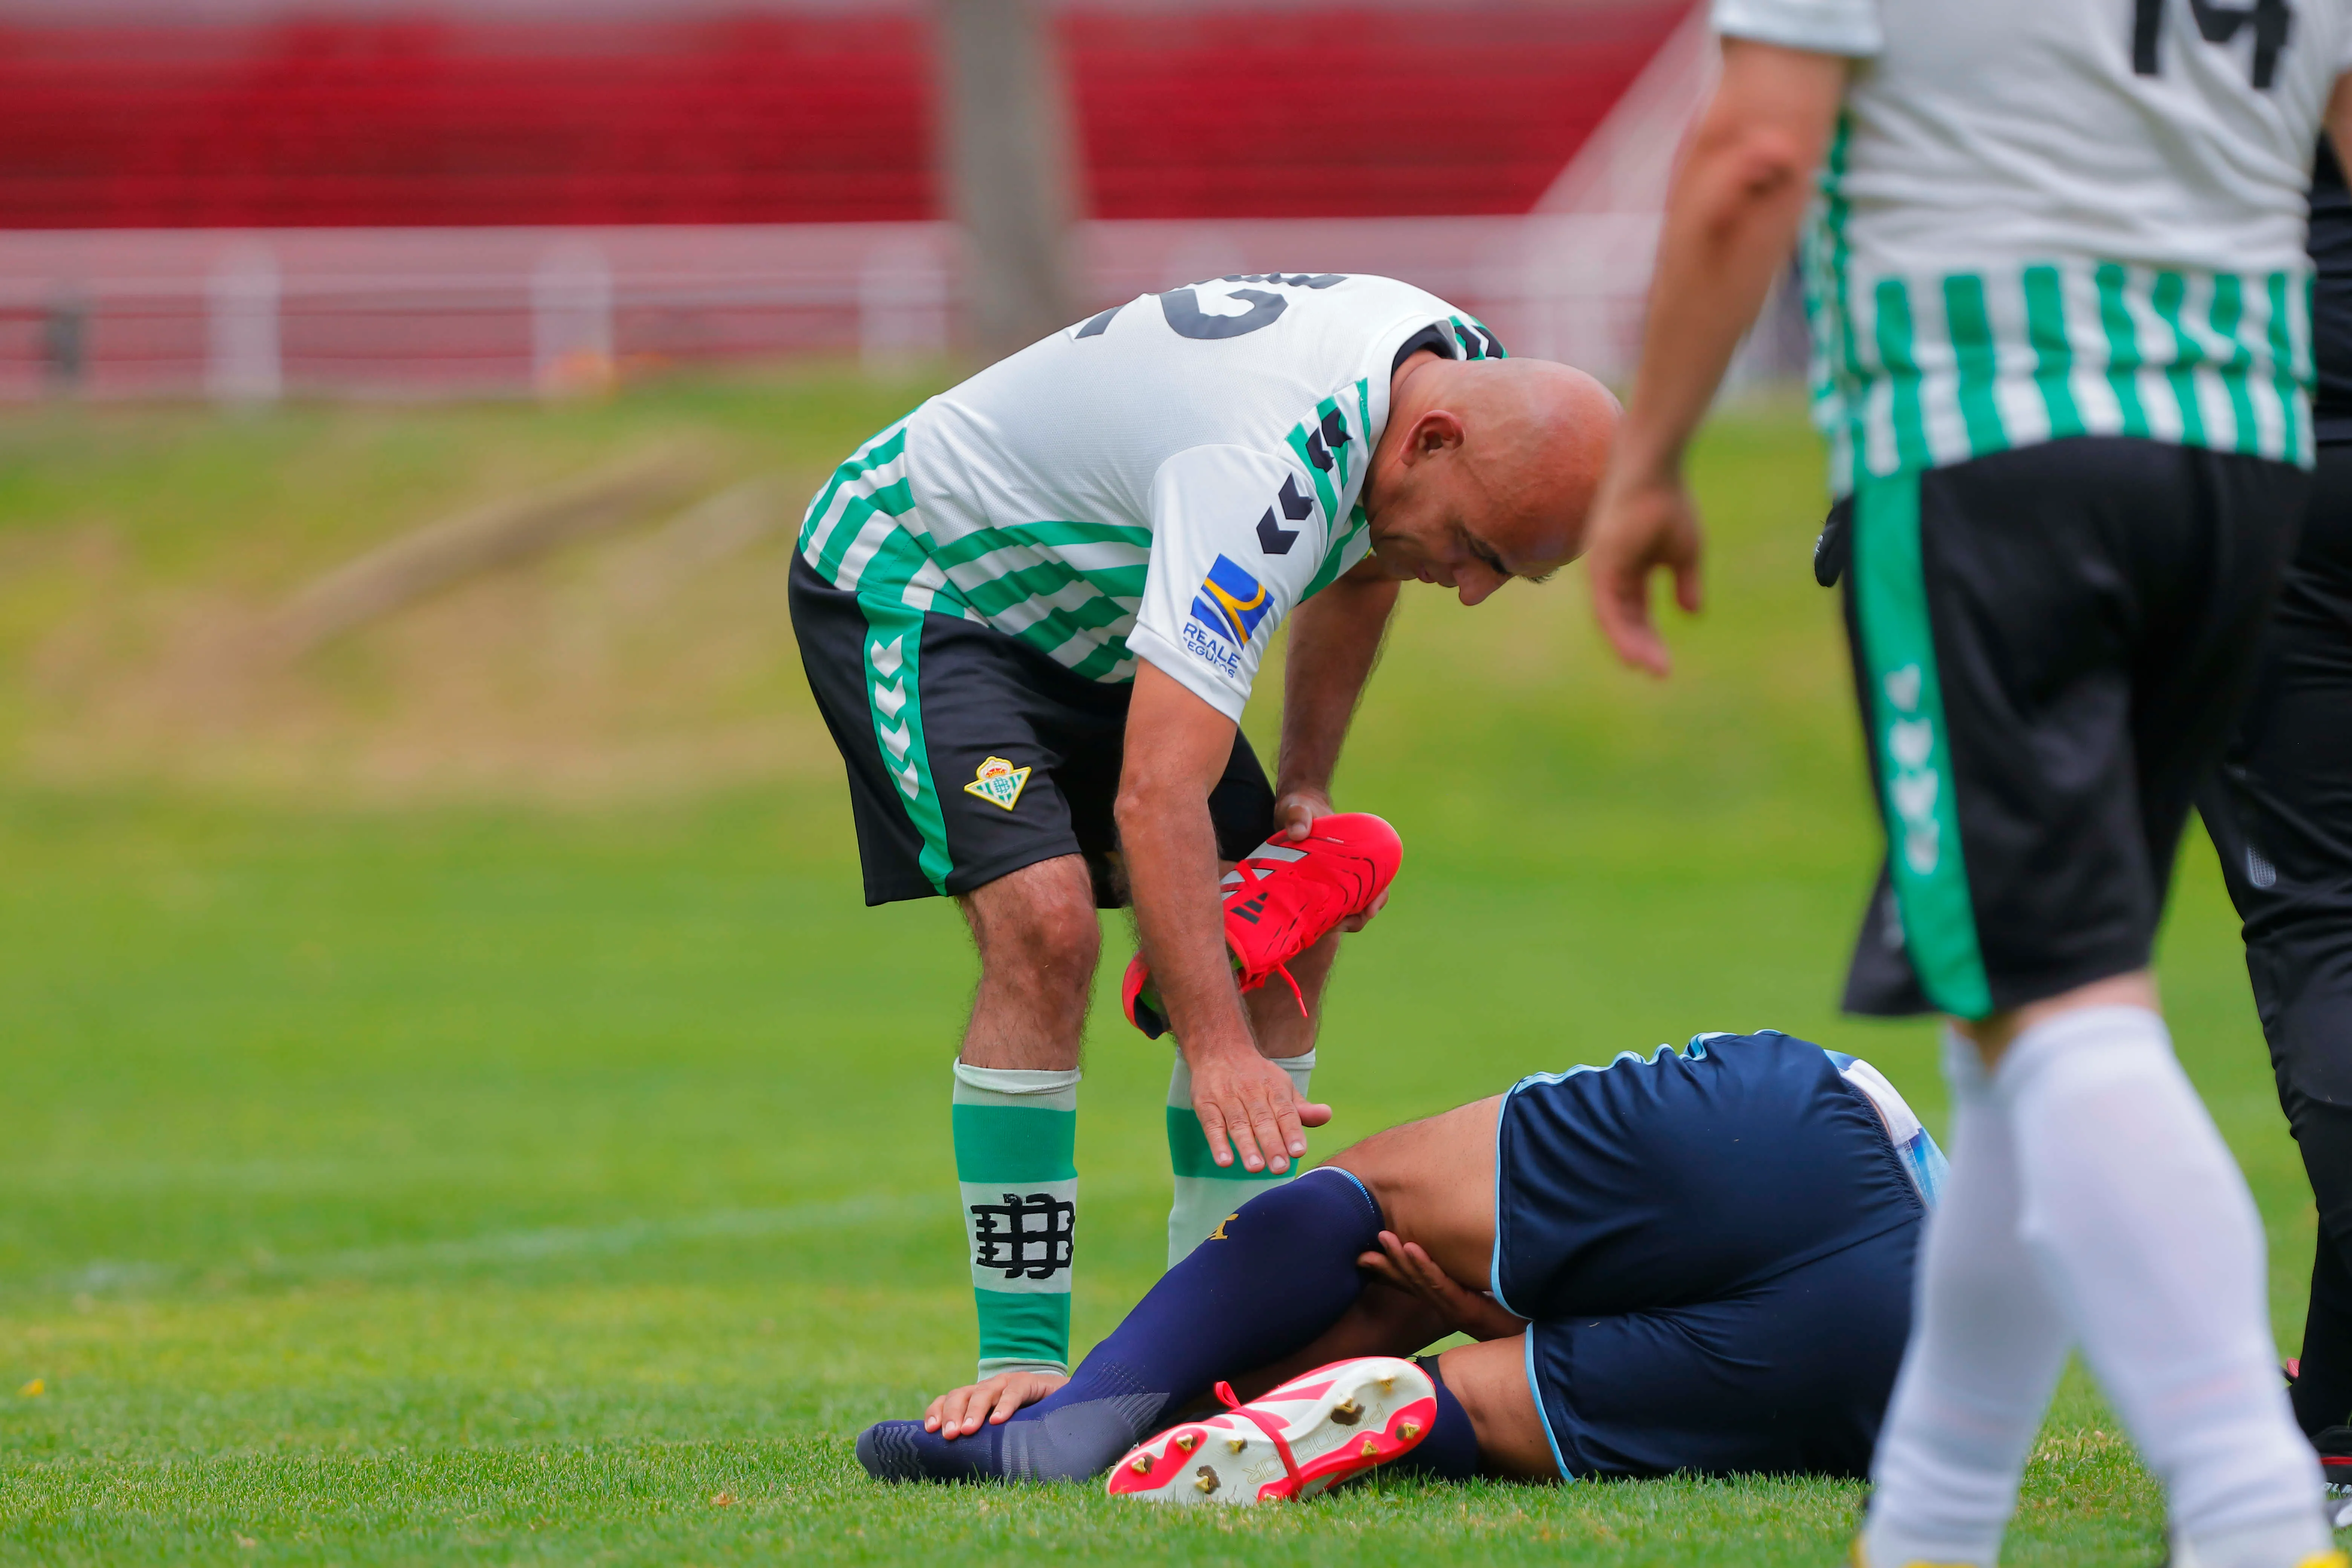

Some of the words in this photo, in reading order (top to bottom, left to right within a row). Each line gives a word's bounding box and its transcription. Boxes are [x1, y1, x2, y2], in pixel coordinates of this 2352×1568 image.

[1183, 622, 1241, 669] REALE
[1183, 636, 1236, 678] EGUS
[1242, 1402, 1387, 1484] PREDAOR
